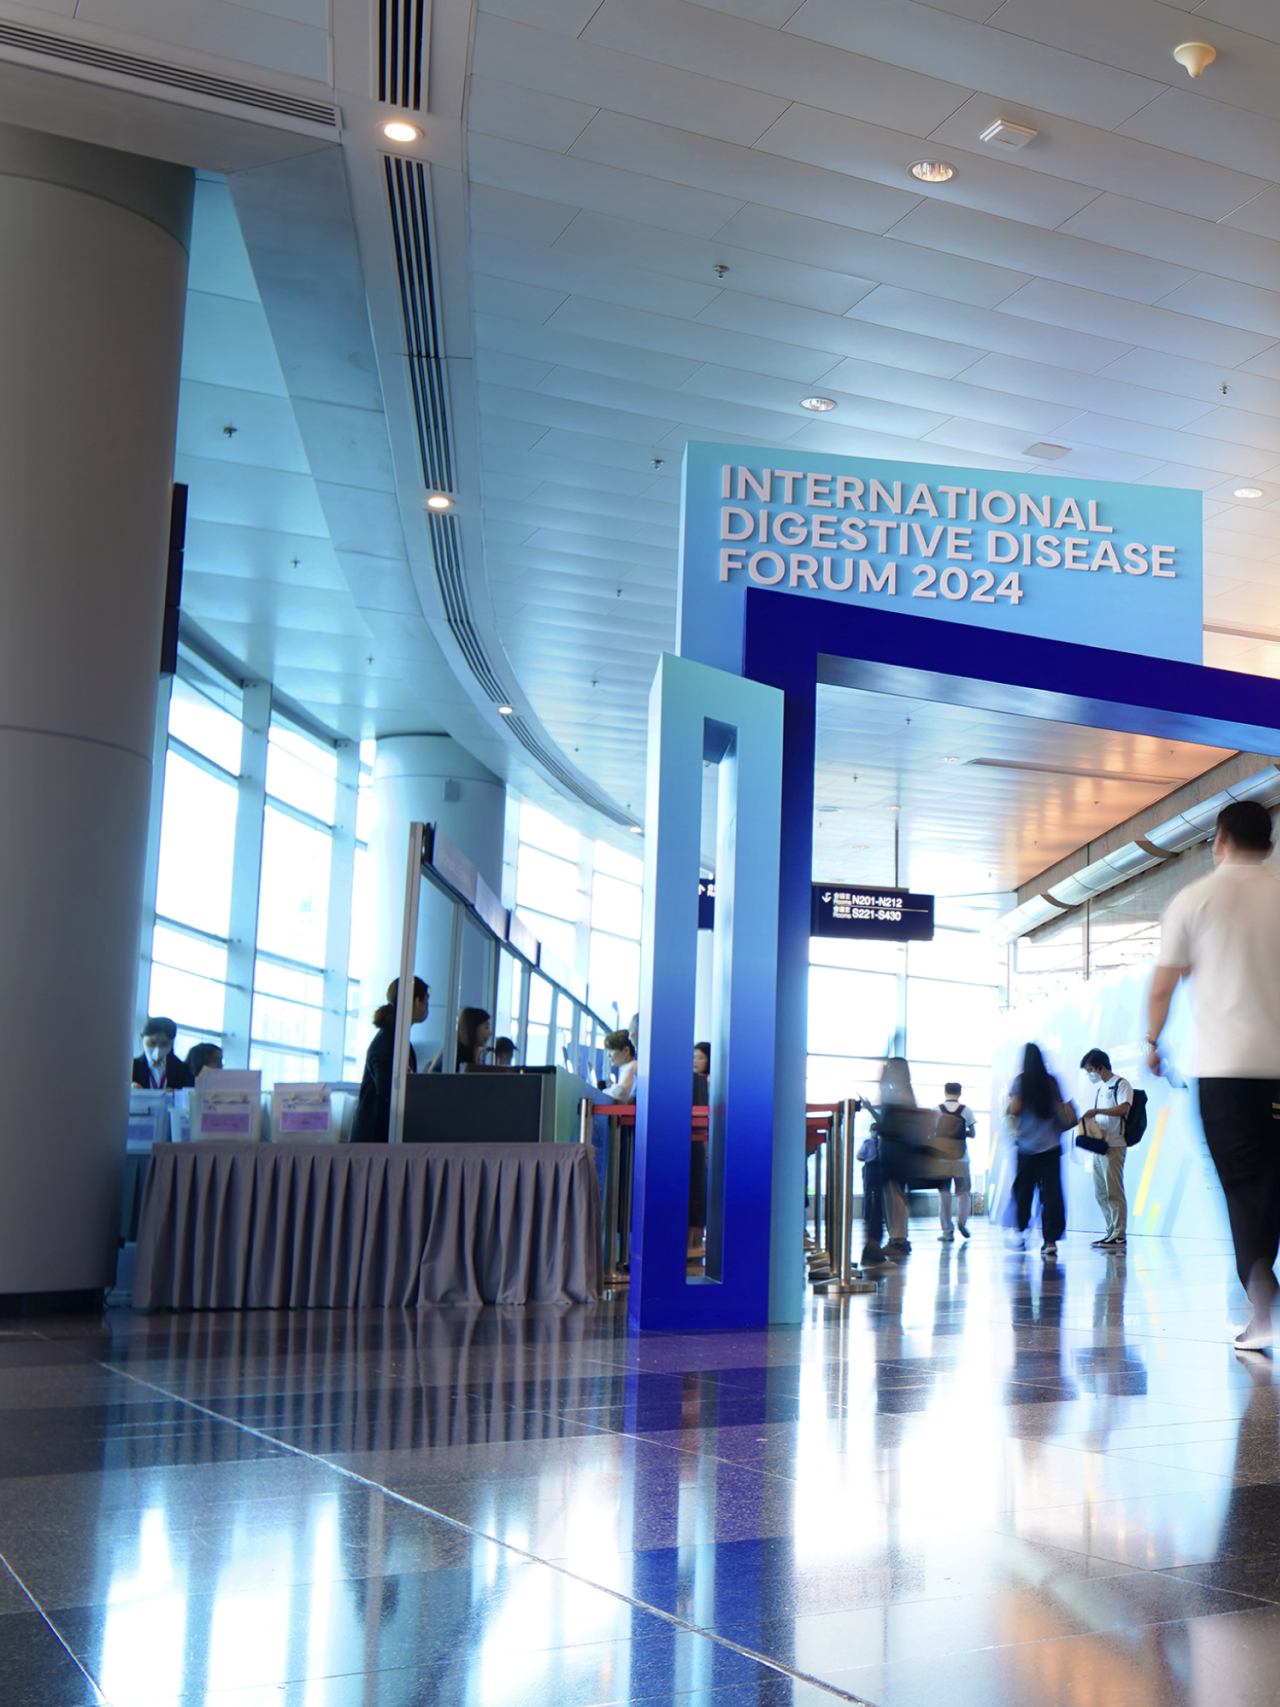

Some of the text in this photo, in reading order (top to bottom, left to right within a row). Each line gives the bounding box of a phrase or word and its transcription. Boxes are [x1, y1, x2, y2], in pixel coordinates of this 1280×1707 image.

[721, 465, 1113, 534] INTERNATIONAL
[720, 506, 1177, 579] DIGESTIVE DISEASE
[719, 548, 1024, 606] FORUM 2024
[852, 894, 903, 908] N201-N212
[852, 907, 902, 921] S221-S430
